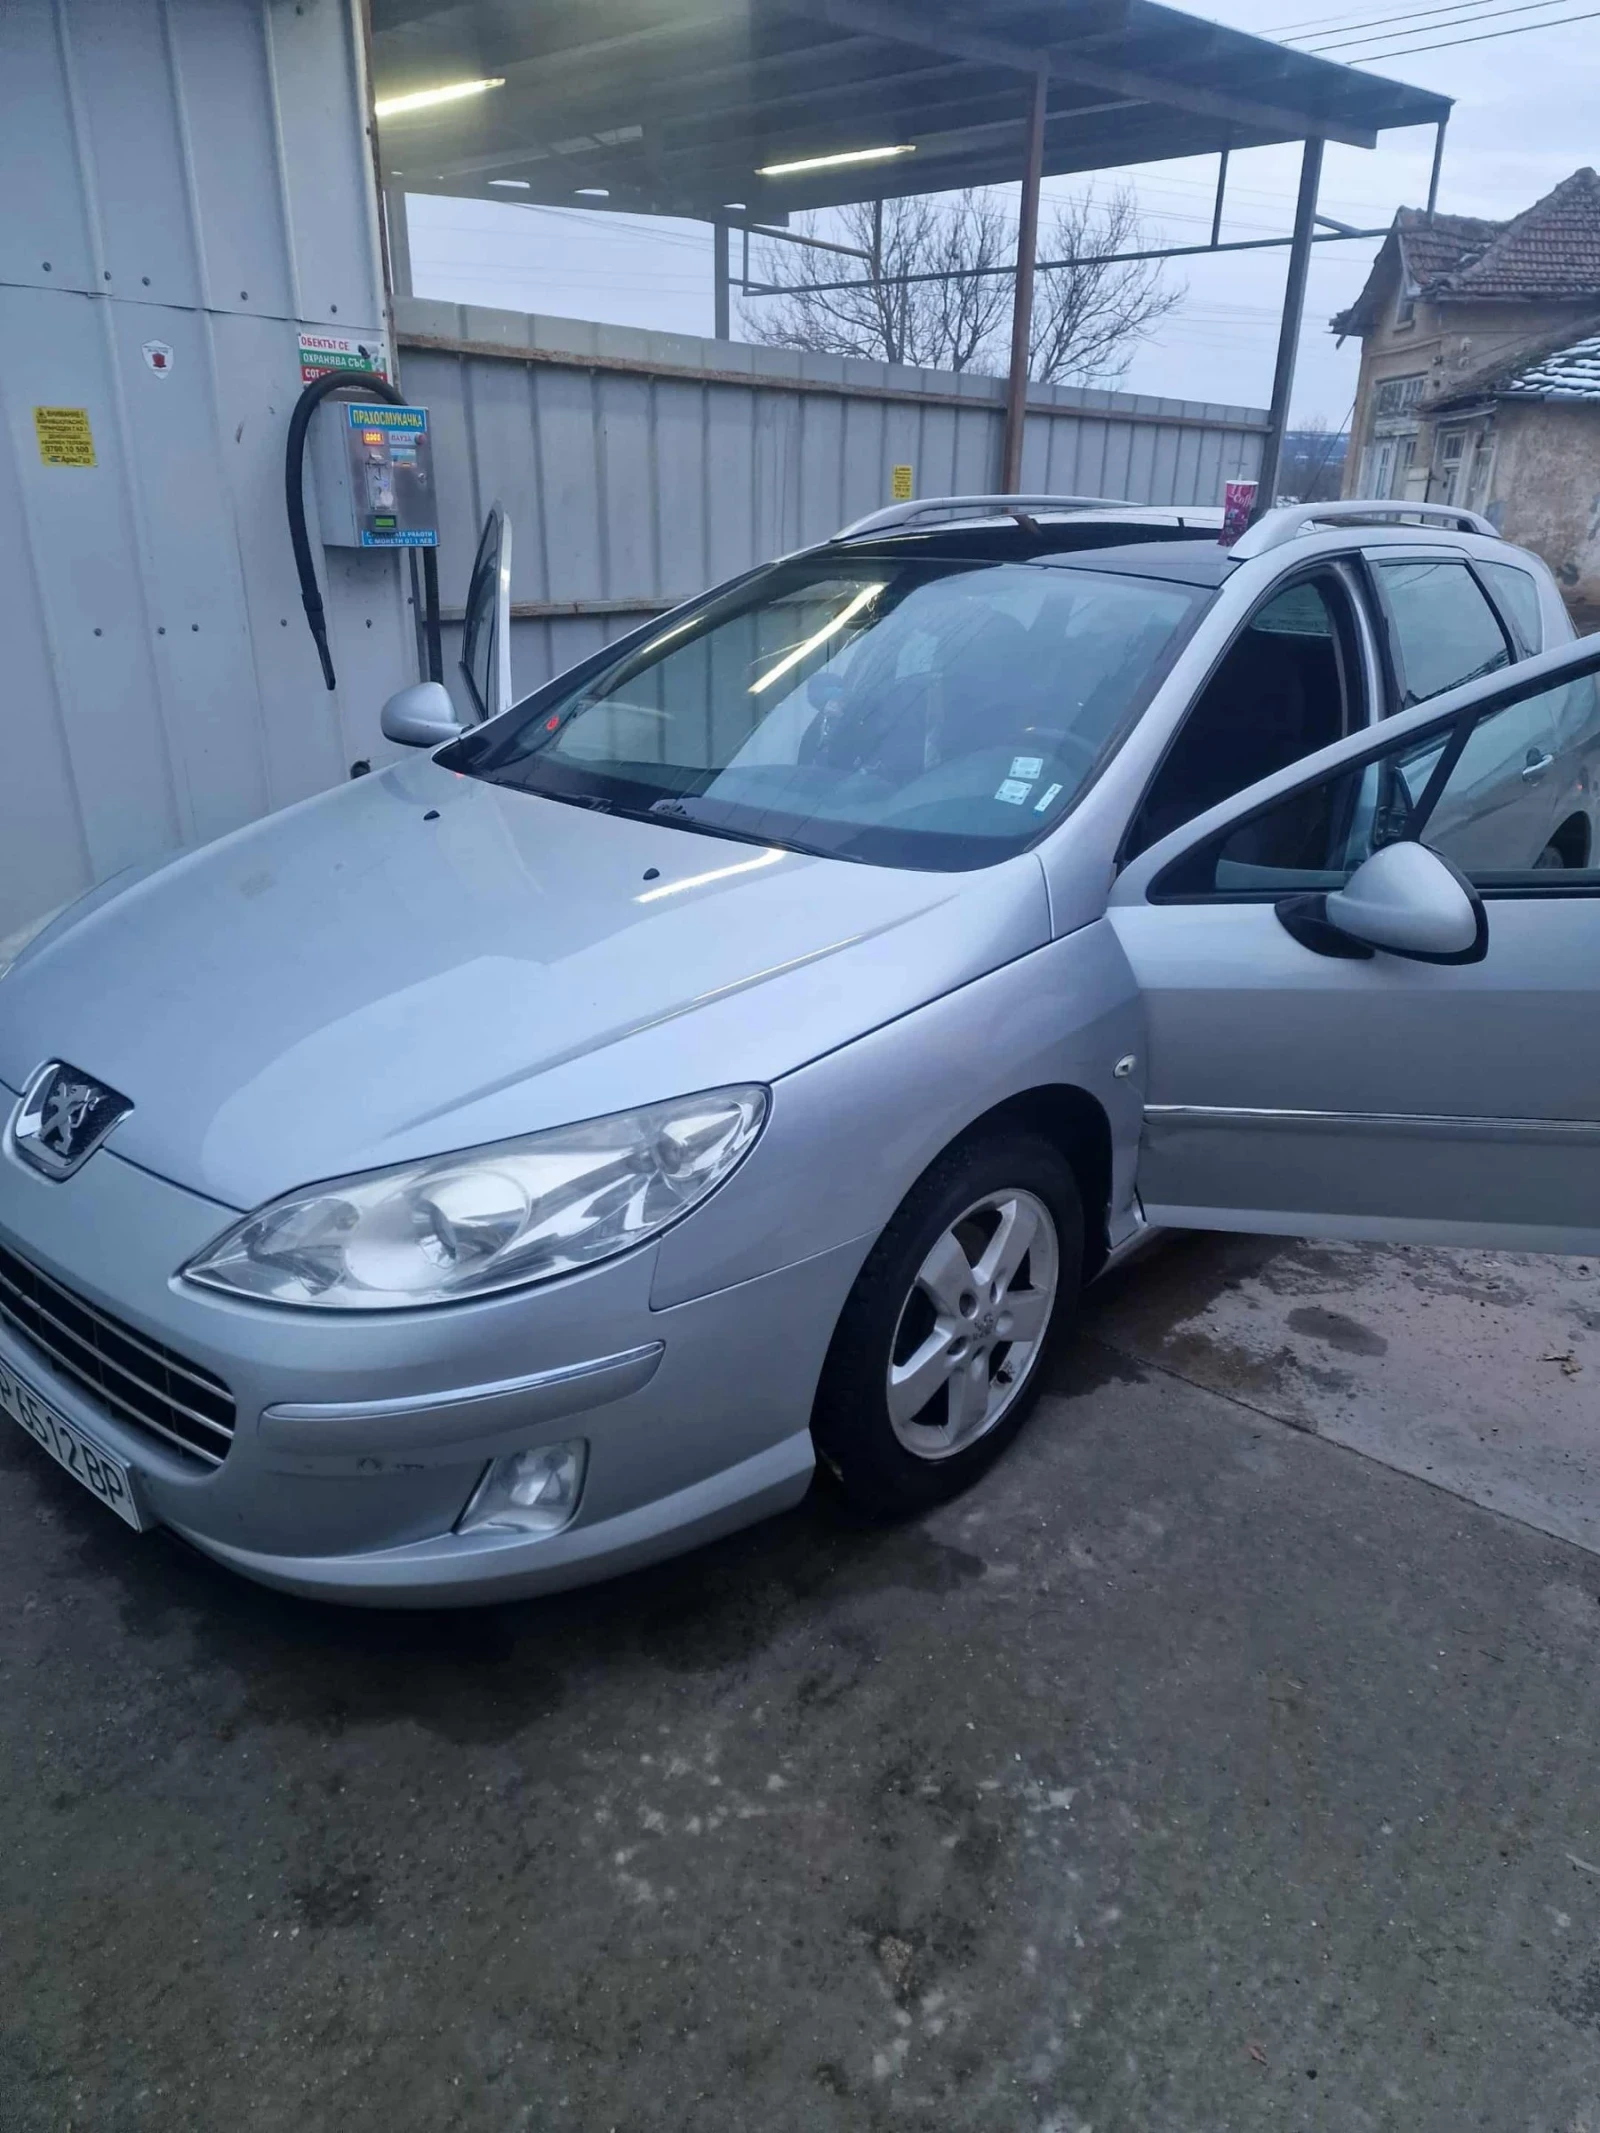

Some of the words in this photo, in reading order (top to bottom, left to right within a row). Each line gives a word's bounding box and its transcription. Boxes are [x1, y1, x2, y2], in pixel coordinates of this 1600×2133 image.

[301, 336, 336, 350] ОБЕКТЪТ
[338, 341, 350, 351] СЕ
[303, 353, 347, 367] ОХРАНЯВА
[347, 357, 365, 369] СЪС
[352, 410, 423, 427] ПРАХОСМУКАЧКА
[16, 1386, 85, 1478] 6512
